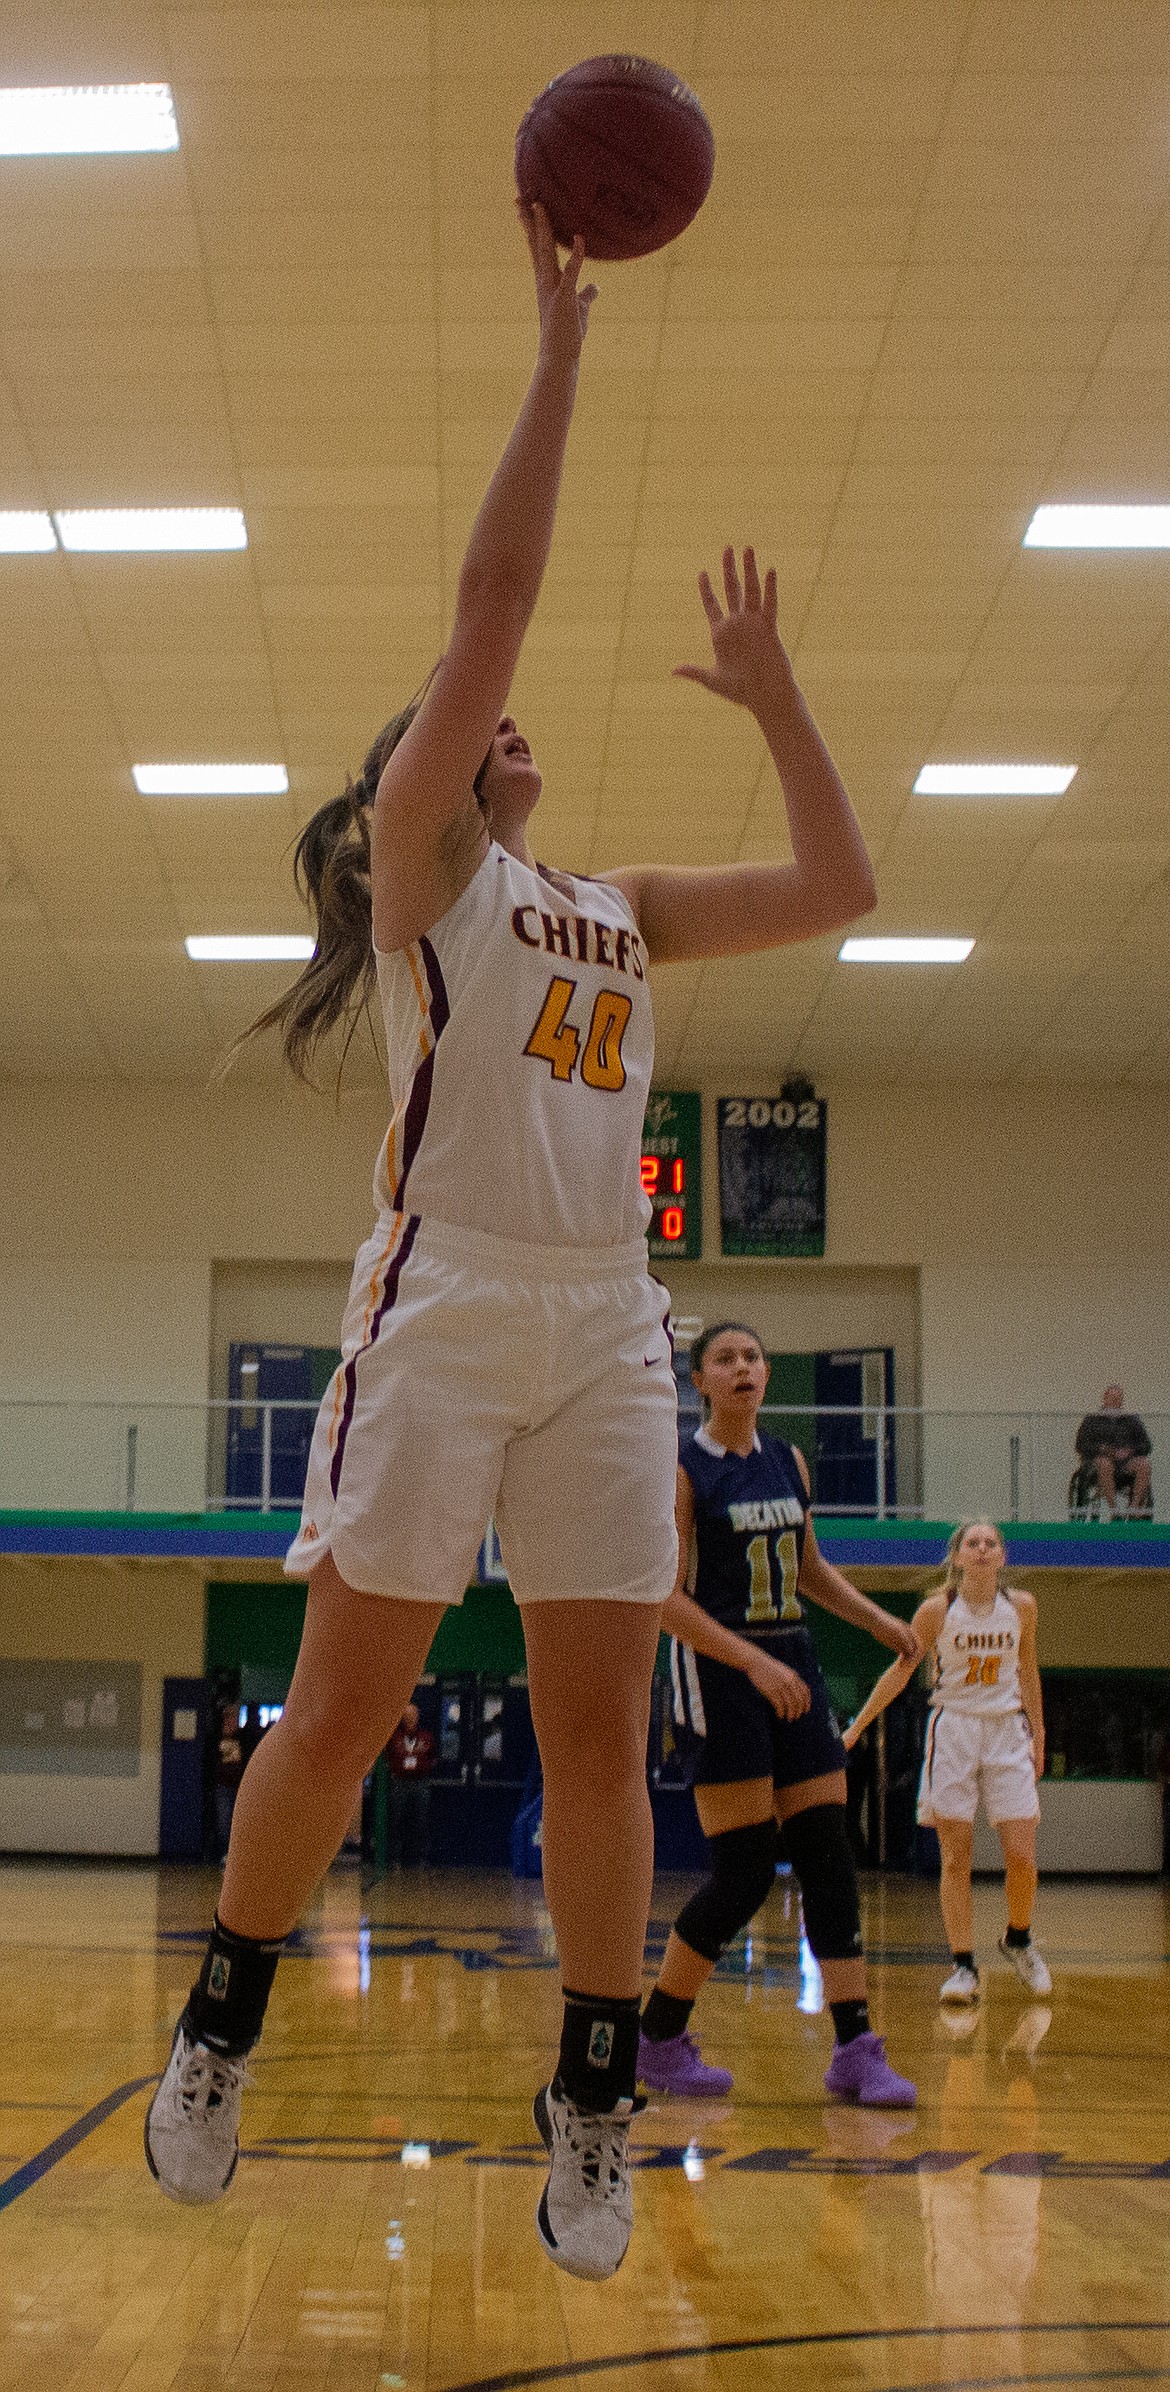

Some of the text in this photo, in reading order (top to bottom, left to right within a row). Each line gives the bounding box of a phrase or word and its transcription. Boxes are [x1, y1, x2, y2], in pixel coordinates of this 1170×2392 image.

[510, 904, 644, 982] CHIEFS
[521, 974, 633, 1093] 40
[723, 1101, 821, 1129] 2002
[642, 1136, 679, 1155] UEST
[640, 1155, 685, 1196] 21
[662, 1206, 684, 1241] 0
[745, 1530, 802, 1623] 11
[954, 1632, 1015, 1651] CHIEFS
